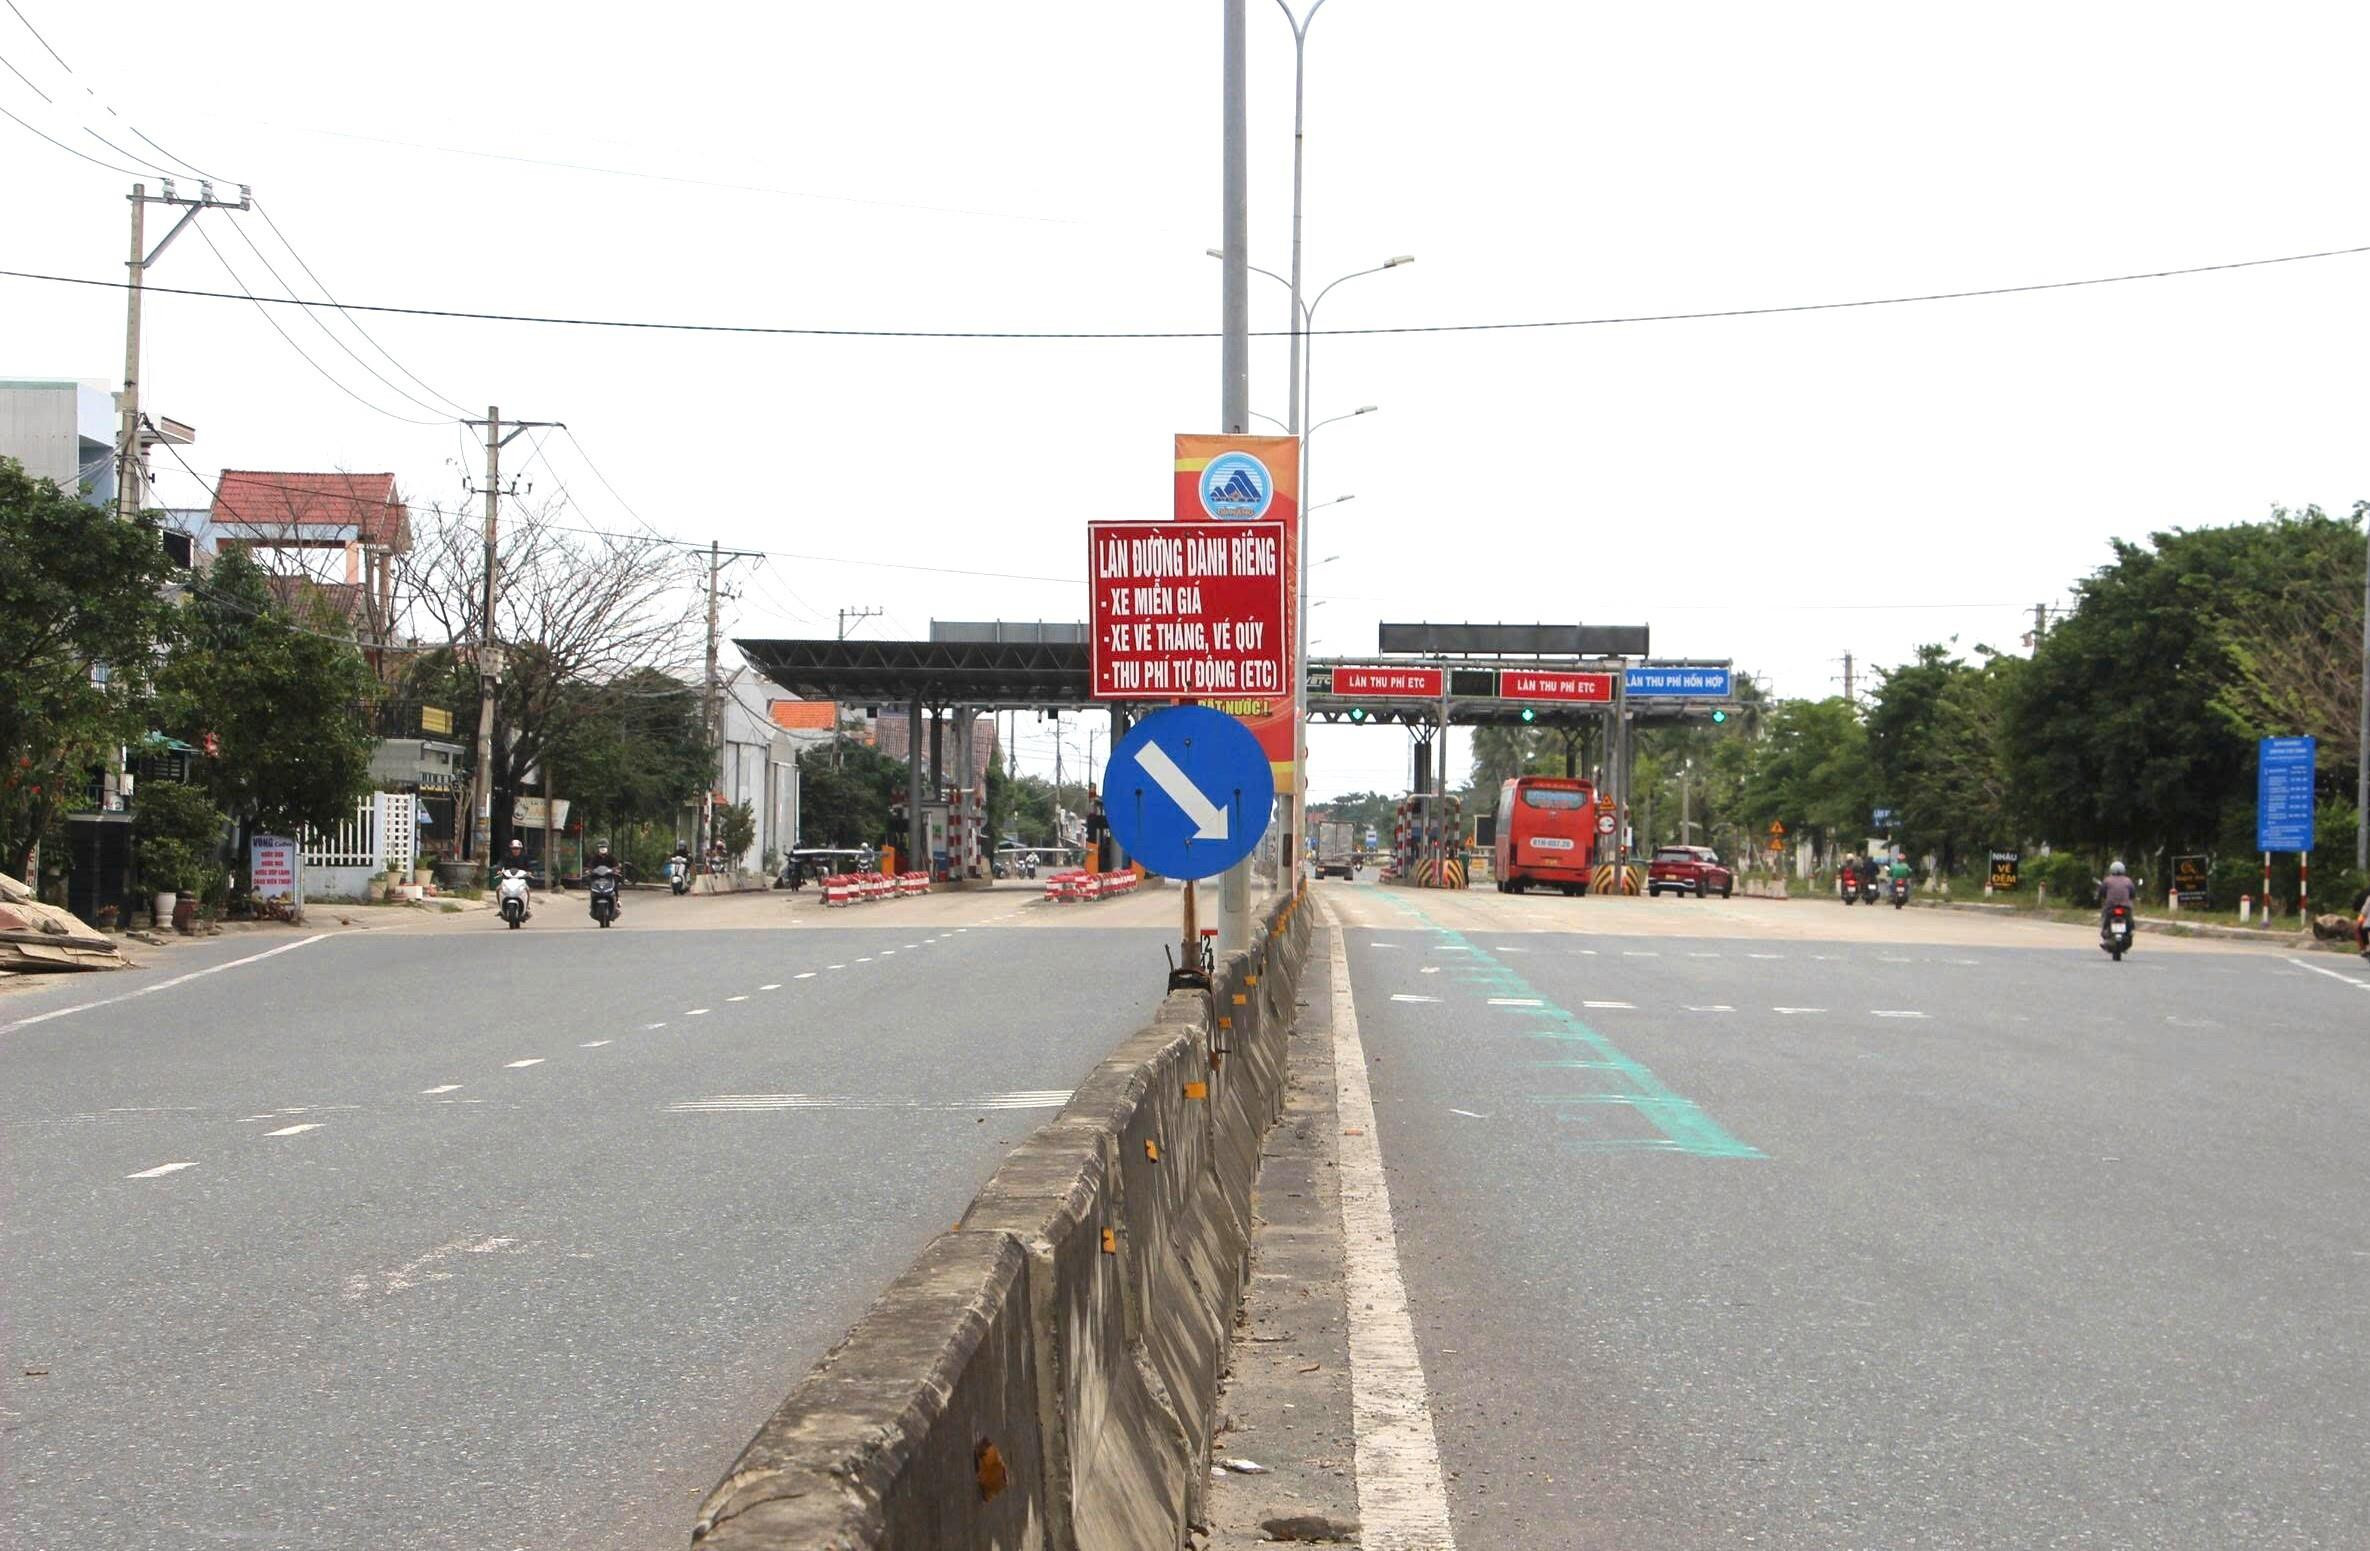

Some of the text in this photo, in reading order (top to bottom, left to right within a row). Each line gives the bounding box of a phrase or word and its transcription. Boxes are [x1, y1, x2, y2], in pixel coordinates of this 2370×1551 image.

[1099, 532, 1129, 579] LÀN
[1132, 527, 1183, 578] ĐƯỜNG
[1186, 530, 1228, 577] DÀNH
[1111, 587, 1130, 616] XE
[1134, 578, 1173, 615] MIỄN
[1177, 579, 1202, 614] GIÁ
[1111, 624, 1130, 652] XE
[1133, 617, 1153, 651] VÉ
[1155, 617, 1209, 654] THÁNG,
[1212, 617, 1231, 650] VÉ
[1111, 661, 1140, 689] THU
[1144, 654, 1169, 688] PHÍ
[1172, 657, 1193, 692] TỰ
[1195, 654, 1236, 692] ĐỘNG
[1240, 660, 1277, 691] (ETC)
[1349, 674, 1425, 689] LÀN THU PHÍ ETC
[1517, 677, 1595, 693] LÀN THU PHÍ ETC
[1625, 674, 1644, 687] LÀN
[1645, 675, 1664, 687] THU
[1666, 674, 1682, 688] PHÍ
